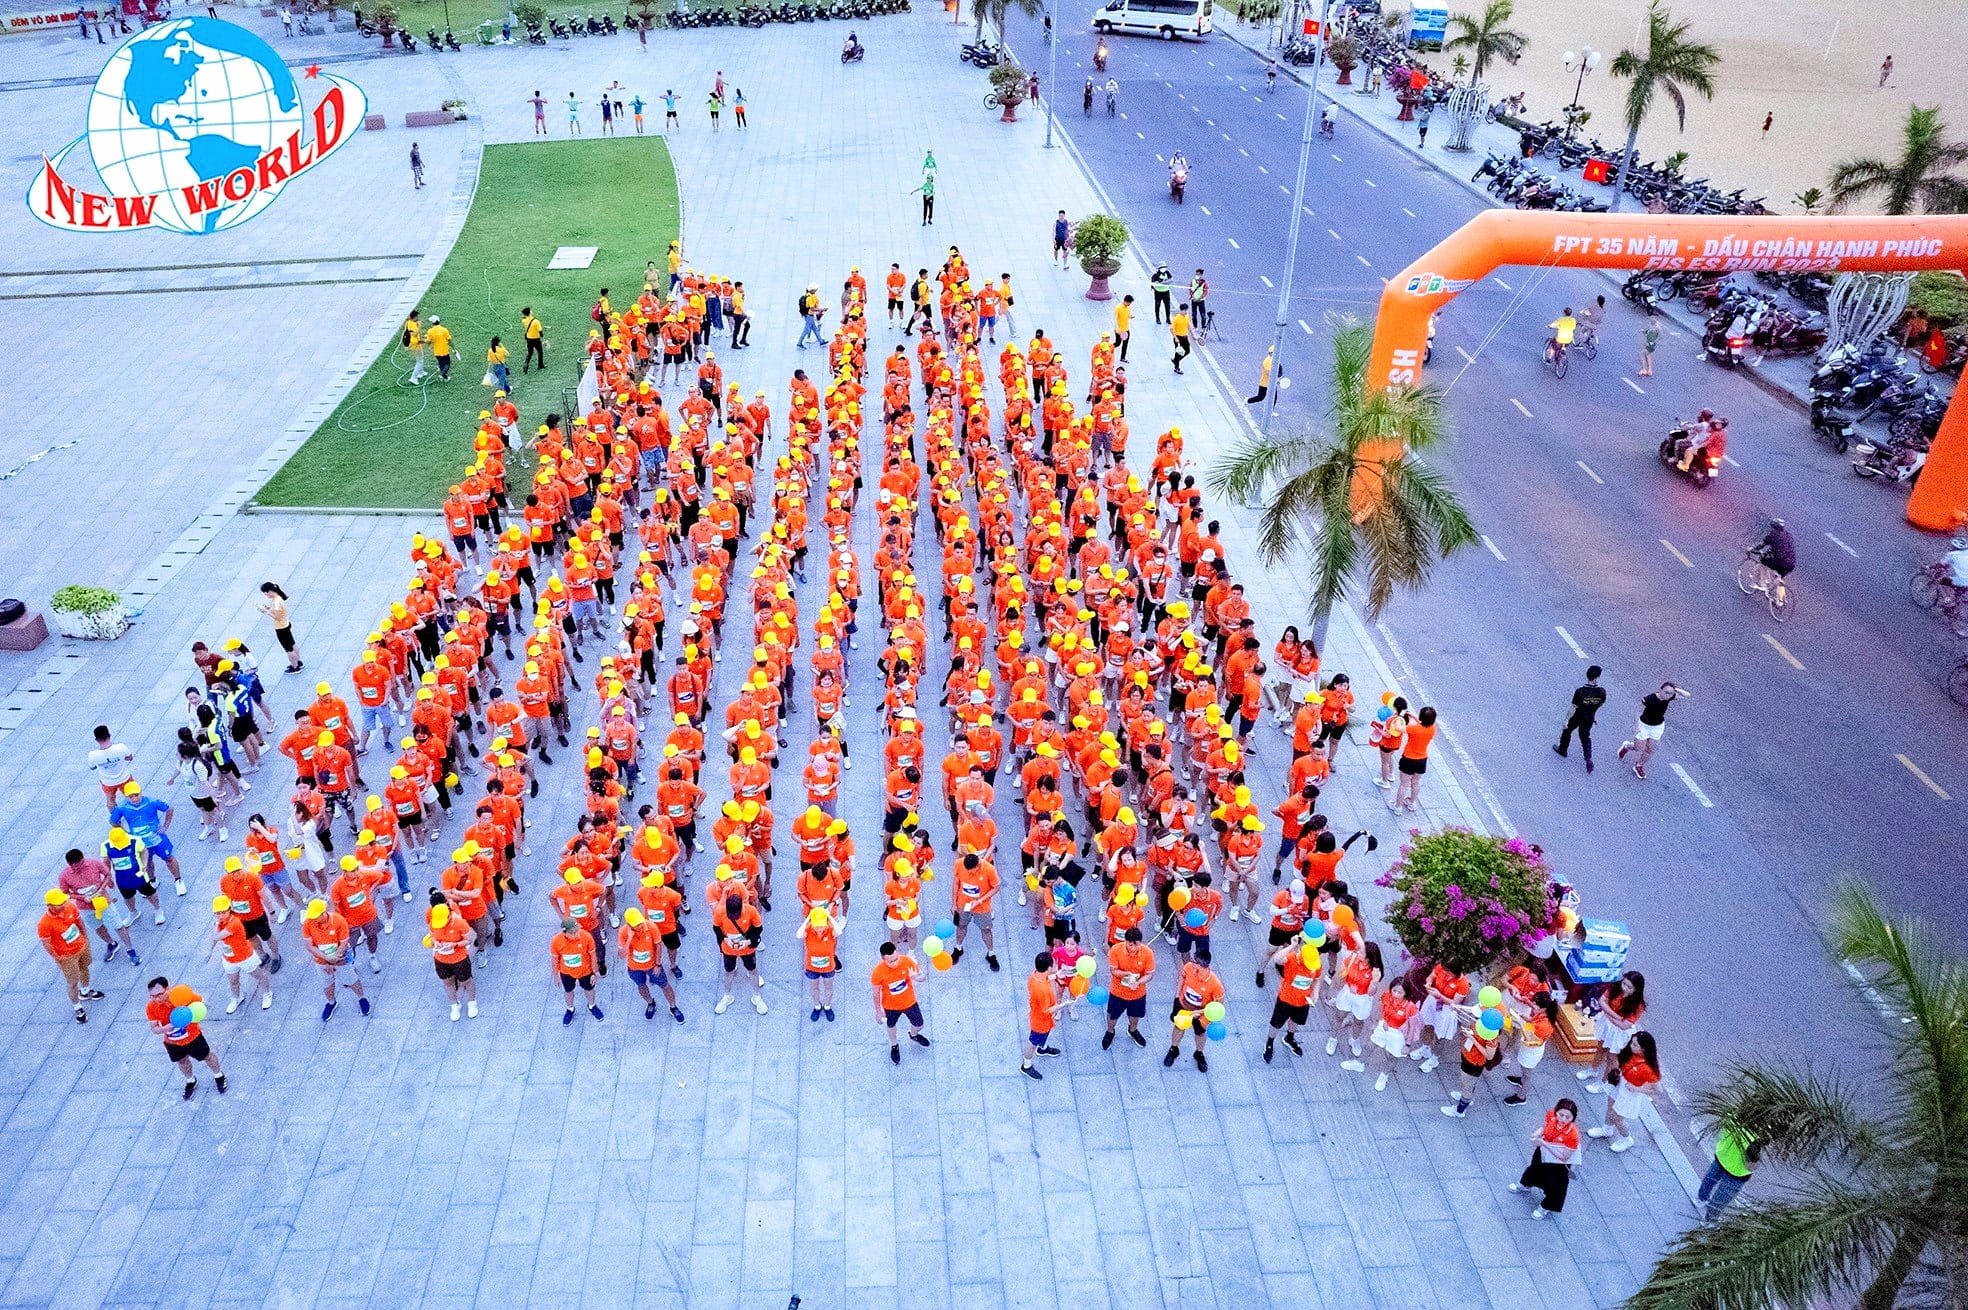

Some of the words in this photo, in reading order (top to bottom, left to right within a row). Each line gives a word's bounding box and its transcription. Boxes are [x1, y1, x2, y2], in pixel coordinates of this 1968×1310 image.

[1553, 235, 1592, 254] FPT
[1596, 238, 1624, 255] 35
[1626, 235, 1679, 257] NĂM
[1703, 233, 1749, 257] DẤU
[1752, 236, 1813, 258] CHÂN
[1880, 236, 1943, 258] PHÚC
